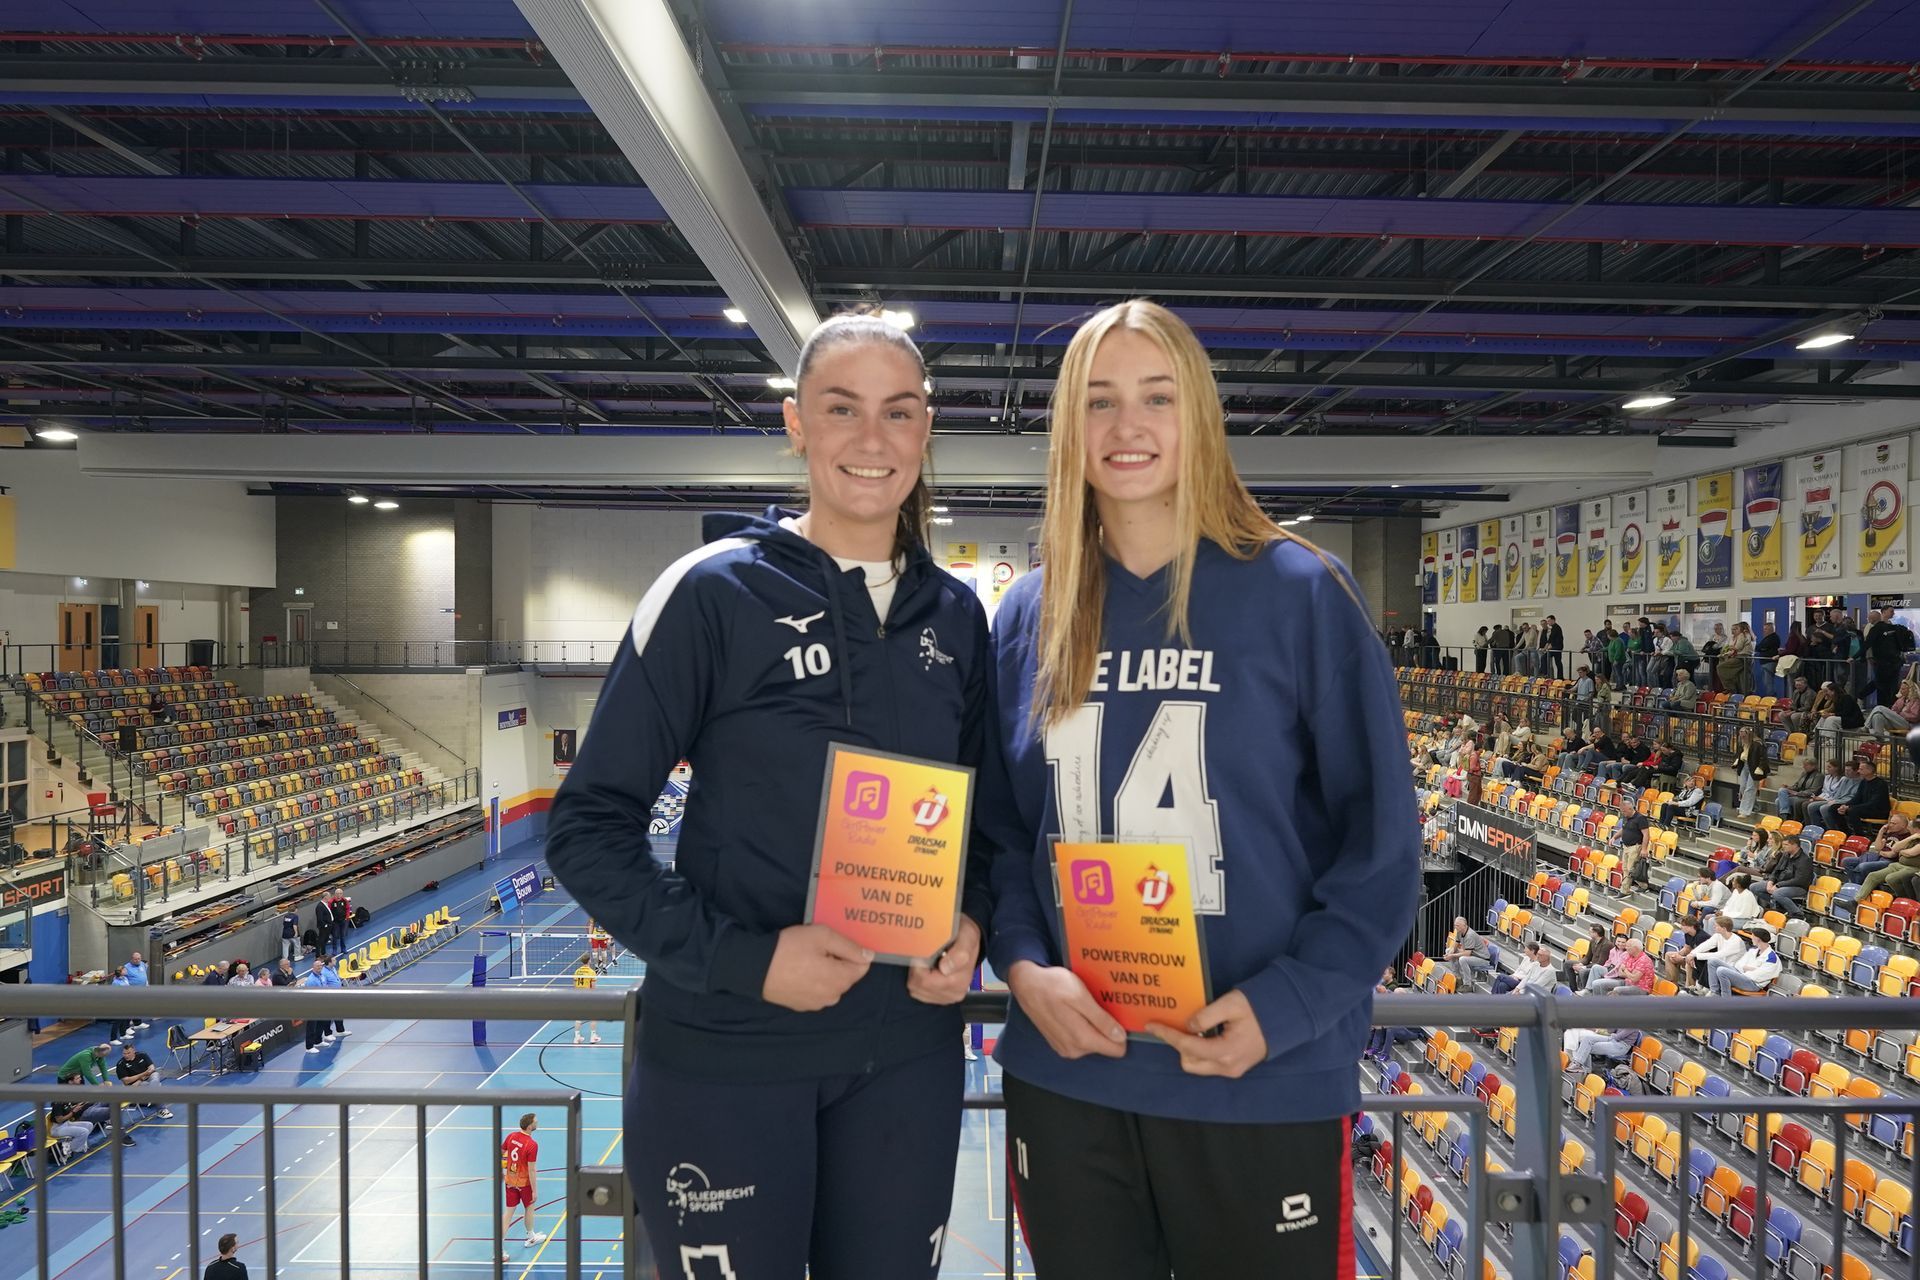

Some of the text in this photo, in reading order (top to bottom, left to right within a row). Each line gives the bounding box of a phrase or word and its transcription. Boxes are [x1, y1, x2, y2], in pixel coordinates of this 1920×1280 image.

[1753, 568, 1770, 579] 2007
[1808, 562, 1828, 573] 2007
[1871, 560, 1893, 571] 2008
[1705, 575, 1721, 585] 2003
[783, 643, 832, 680] 10
[1118, 648, 1221, 692] LABEL
[907, 835, 947, 848] DRAISMA
[1458, 815, 1531, 860] OMNISPORT
[512, 870, 535, 889] Draisma
[834, 861, 944, 888] POWERVROUW
[515, 884, 533, 899] Bouw
[861, 887, 913, 906] VAN DE
[844, 907, 924, 929] WEDSTRIJD
[1140, 916, 1180, 927] DRAISMA
[1081, 948, 1186, 968] POWERVROUW
[1110, 970, 1161, 987] VAN DE
[1100, 990, 1177, 1009] WEDSTRIJD
[252, 1024, 284, 1045] STANNO
[511, 1147, 519, 1162] 6
[687, 1185, 756, 1201] SLIEDRECHT
[688, 1200, 725, 1213] SPORT
